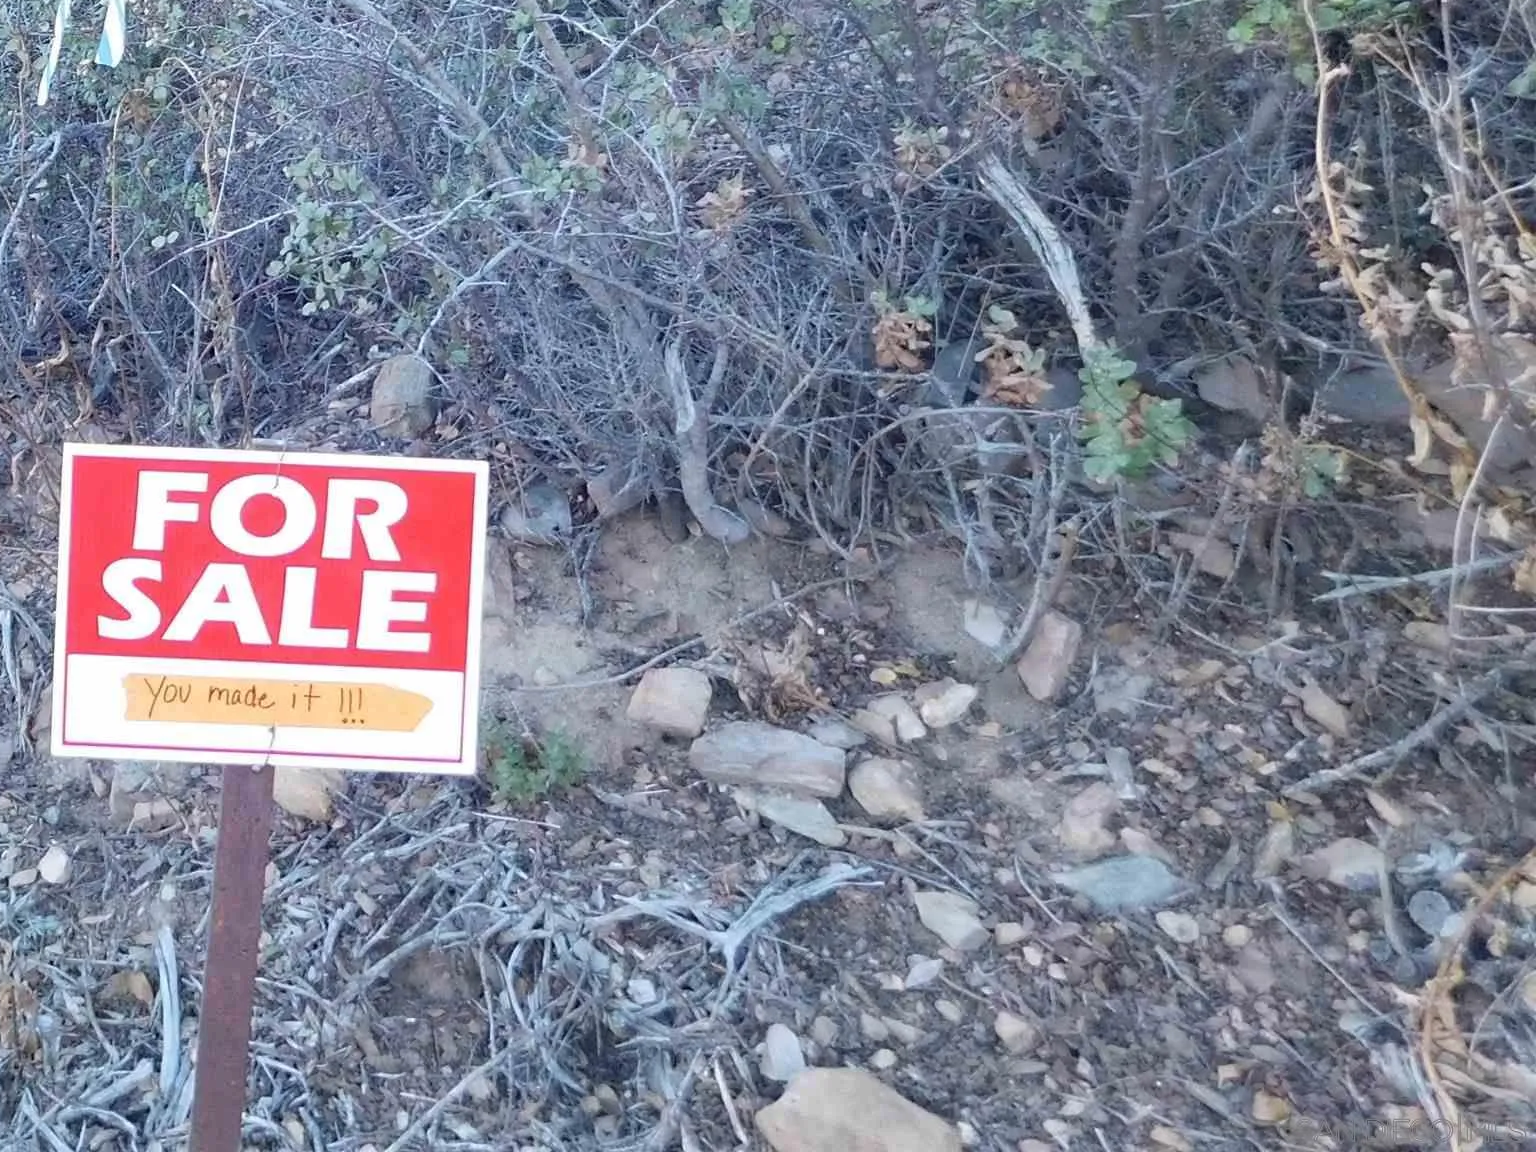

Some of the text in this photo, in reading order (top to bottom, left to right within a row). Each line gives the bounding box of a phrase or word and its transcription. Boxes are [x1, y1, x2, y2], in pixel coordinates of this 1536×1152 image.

[132, 470, 408, 561] FOR
[97, 557, 437, 652] SALE
[144, 675, 192, 719] You
[207, 683, 276, 710] made
[290, 684, 321, 712] it
